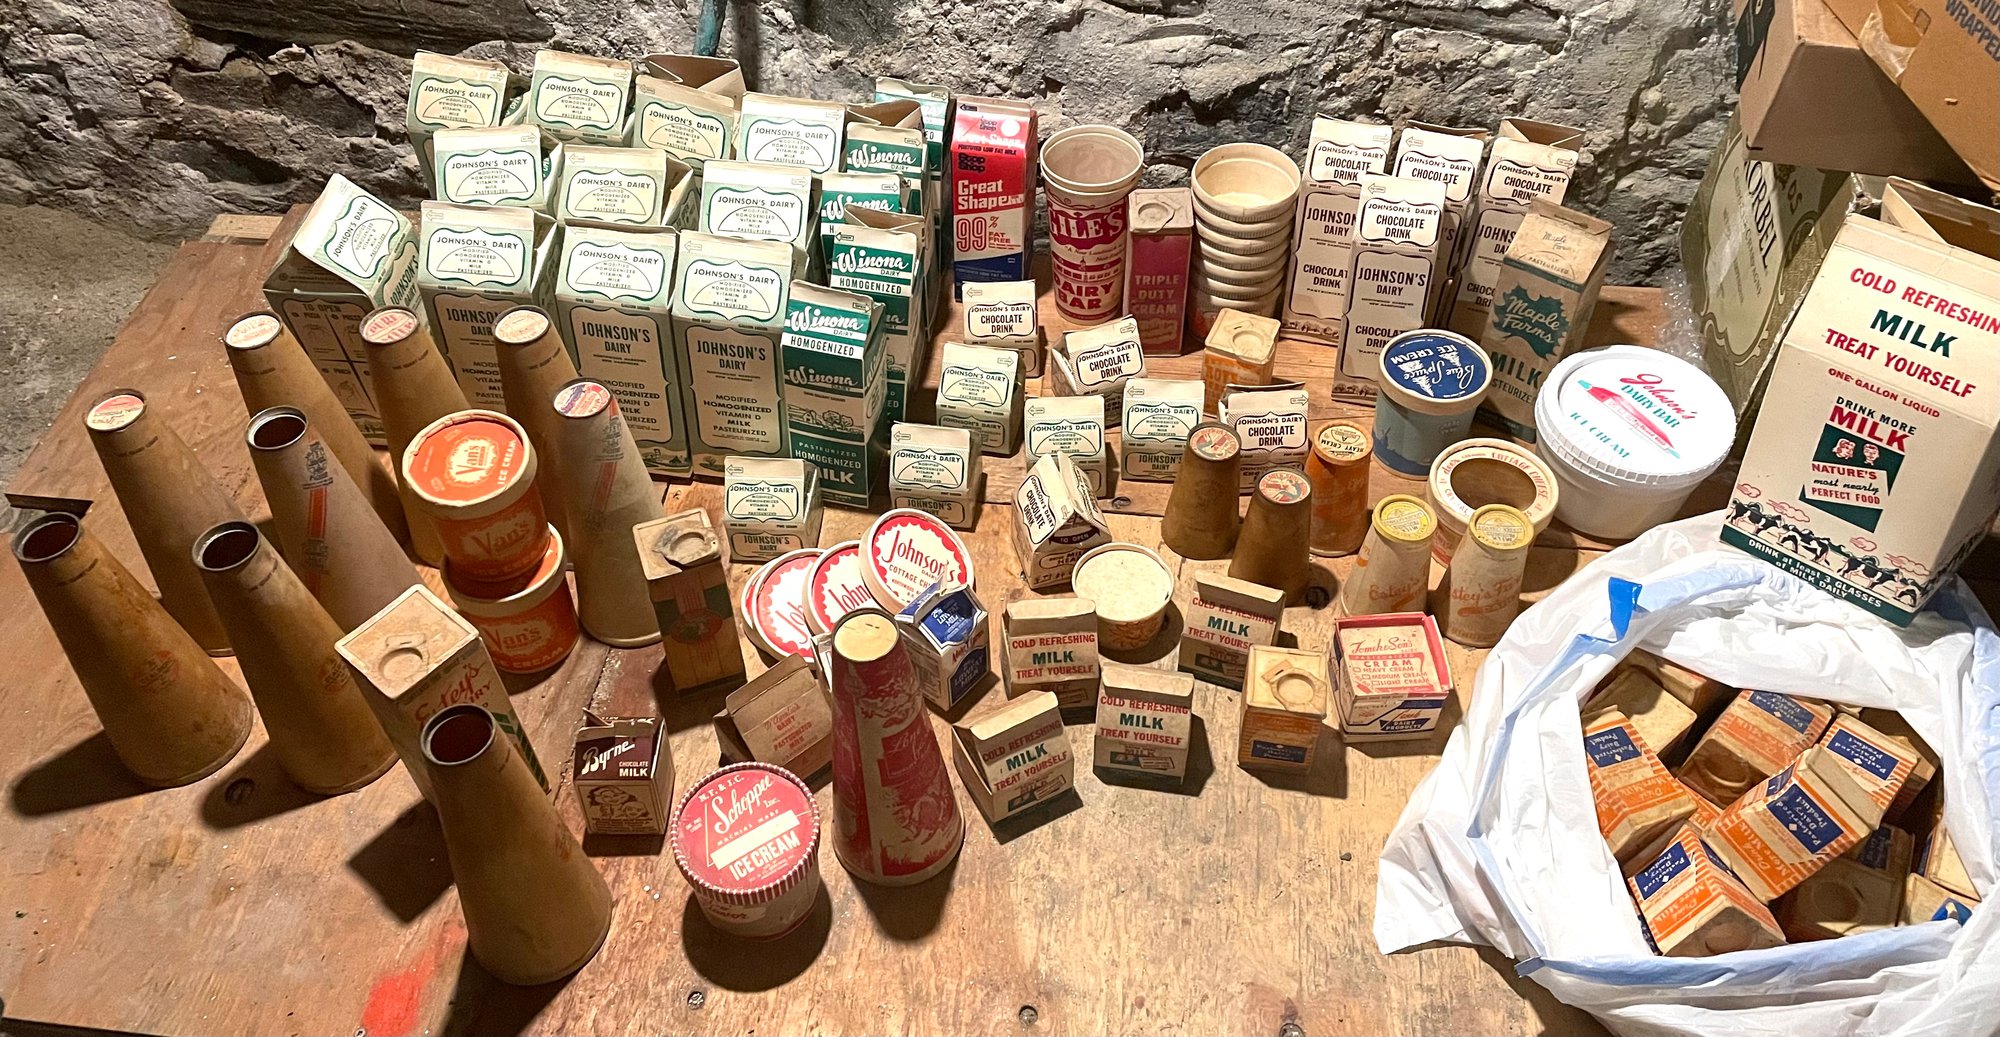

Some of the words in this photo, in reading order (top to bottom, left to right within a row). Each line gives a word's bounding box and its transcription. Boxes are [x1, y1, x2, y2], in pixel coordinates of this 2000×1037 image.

[849, 145, 916, 168] Winona
[1325, 157, 1371, 172] CHOCOLATE
[1405, 156, 1446, 168] JOHNSON'S
[1334, 170, 1358, 181] DRINK
[958, 180, 1003, 195] Great
[1504, 176, 1552, 194] CHOCOLATE
[958, 194, 1008, 210] Shape
[1368, 204, 1411, 213] JOHNSON'S
[1415, 208, 1438, 216] DAIRY
[1324, 225, 1349, 237] DAIRY
[1376, 215, 1425, 229] CHOCOLATE
[956, 217, 987, 252] 99
[1385, 228, 1411, 239] DRINK
[436, 237, 487, 246] JOHNSON'S
[492, 241, 518, 249] DAIRY
[578, 249, 628, 261] JOHNSON'S
[633, 255, 659, 265] DAIRY
[835, 248, 908, 272] Winona
[694, 268, 743, 280] JOHNSON'S
[749, 275, 775, 285] DAIRY
[839, 277, 902, 294] HOMOGENIZED
[1054, 273, 1114, 297] DAIRY
[1135, 275, 1180, 285] TRIPLE
[1313, 277, 1340, 289] DRINK
[1358, 268, 1426, 286] JOHNSON'S
[1058, 288, 1101, 309] BAR
[1139, 290, 1174, 299] DUTY
[1376, 285, 1403, 296] DAIRY
[1133, 304, 1176, 314] CREAM
[1850, 268, 1896, 294] COLD
[1902, 286, 2000, 335] REFRESHIN
[787, 306, 863, 331] Winona
[981, 314, 1023, 324] CHOCOLATE
[1506, 296, 1560, 331] Maple
[582, 321, 650, 343] JOHNSON'S
[992, 324, 1013, 333] DRINK
[1502, 314, 1553, 343] Farms
[1870, 308, 1958, 359] MILK
[605, 342, 631, 354] DAIRY
[697, 339, 766, 361] JOHNSON'S
[790, 336, 854, 357] HOMOGENIZED
[1436, 345, 1457, 354] ICE
[719, 358, 746, 371] DAIRY
[1090, 353, 1130, 372] CHOCOLATE
[1390, 349, 1434, 364] CREAM
[1824, 328, 1880, 360] TREAT
[1884, 352, 1976, 399] YOURSELF
[787, 366, 858, 386] Winona
[1101, 367, 1123, 379] DRINK
[1404, 361, 1444, 384] Spruce
[1446, 365, 1474, 389] Blue
[1491, 352, 1542, 389] MILK
[716, 394, 757, 404] MODIFIED
[1492, 379, 1534, 403] STEURIZE
[1619, 374, 1697, 419] Johnson's
[1828, 368, 1898, 401] ONE-GALLON
[1903, 397, 1940, 418] LIQUID
[704, 400, 772, 414] HOMOGENIZED
[715, 410, 747, 419] VITAMIN
[751, 413, 762, 421] D
[1621, 385, 1654, 409] DAIRY
[1653, 408, 1680, 428] BAR
[1836, 396, 1875, 419] DRINK
[1880, 410, 1917, 435] MORE
[713, 425, 767, 437] PASTEURIZED
[727, 419, 751, 427] MILK
[1033, 424, 1073, 432] JOHNSON'S
[1248, 426, 1294, 437] CHOCOLATE
[1830, 405, 1910, 453] MILK
[798, 441, 857, 458] PASTEURIZED
[1259, 437, 1283, 446] DRINK
[1321, 440, 1341, 449] CREAM
[456, 444, 485, 476] Van's
[497, 467, 508, 485] ICE
[503, 440, 516, 465] CREAM
[795, 449, 861, 469] HOMOGENIZED
[1491, 453, 1530, 470] COTTAGE
[1811, 463, 1877, 480] NATURE'S
[1813, 478, 1839, 487] most
[1842, 481, 1880, 495] nearly
[1811, 487, 1850, 501] PERFECT
[1856, 493, 1880, 505] FOOD
[1024, 503, 1033, 527] DRINK
[1026, 490, 1046, 529] CHOCOLATE
[471, 521, 529, 556] Van's
[744, 535, 790, 544] JOHNSON'S
[1072, 534, 1089, 542] OPEN
[889, 565, 918, 583] COTTAGE
[1748, 539, 1780, 558] DRINK
[1782, 555, 1794, 564] at
[1797, 562, 1821, 577] least
[1823, 575, 1831, 583] 3
[1835, 579, 1882, 607] GLASSES
[1775, 561, 1787, 570] of
[1790, 566, 1816, 584] MILK
[1819, 580, 1848, 599] DAILY
[1192, 597, 1215, 609] COLD
[1219, 603, 1275, 625] REFRESHING
[1207, 616, 1250, 637] MILK
[481, 626, 542, 649] Van's
[1012, 637, 1036, 649] COLD
[1040, 634, 1095, 646] REFRESHING
[1033, 651, 1073, 665] MILK
[1016, 668, 1043, 679] TREAT
[1048, 665, 1093, 676] YOURSELF
[1101, 696, 1125, 707] COLD
[1129, 700, 1189, 714] REFRESHING
[1119, 713, 1163, 730] MILK
[983, 747, 1006, 763] COLD
[1008, 720, 1061, 750] REFRESHING
[1100, 728, 1128, 739] TREAT
[1134, 731, 1182, 746] YOURSELF
[582, 740, 636, 775] Byrne
[1006, 743, 1048, 771] MILK
[619, 768, 648, 777] MILK
[994, 773, 1020, 791] TREAT
[1024, 752, 1067, 778] YOURSELF
[711, 776, 773, 834] Schoppee
[729, 861, 755, 881] ICE
[751, 830, 800, 867] CREAM
